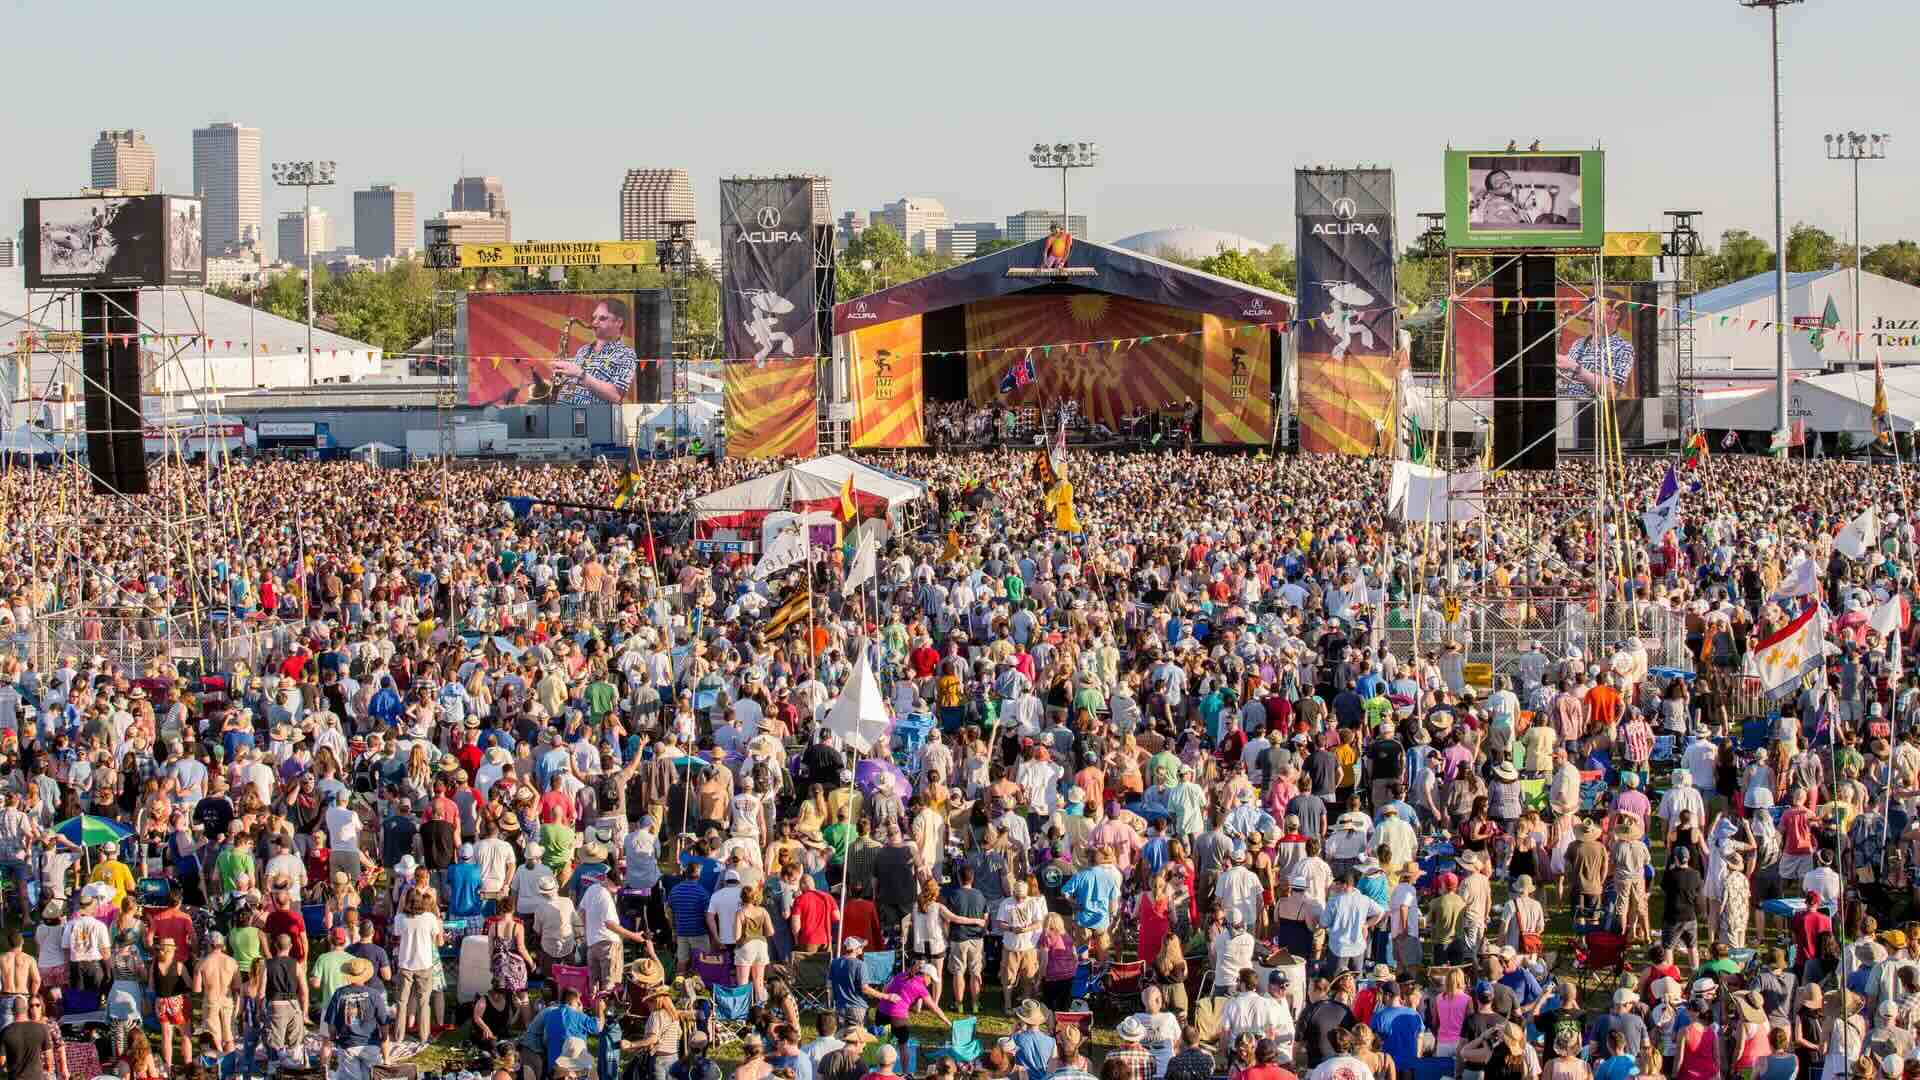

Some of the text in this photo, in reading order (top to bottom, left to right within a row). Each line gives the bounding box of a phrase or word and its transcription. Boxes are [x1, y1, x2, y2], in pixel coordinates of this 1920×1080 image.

[1312, 223, 1380, 235] ACURA
[736, 231, 802, 243] ACURA
[513, 244, 532, 255] NEW
[534, 243, 571, 254] ORLEANS
[573, 242, 592, 253] JAZZ
[514, 254, 600, 265] HERITAGE FESTIVAL
[1872, 316, 1919, 329] Jazz
[1787, 409, 1814, 417] CURA
